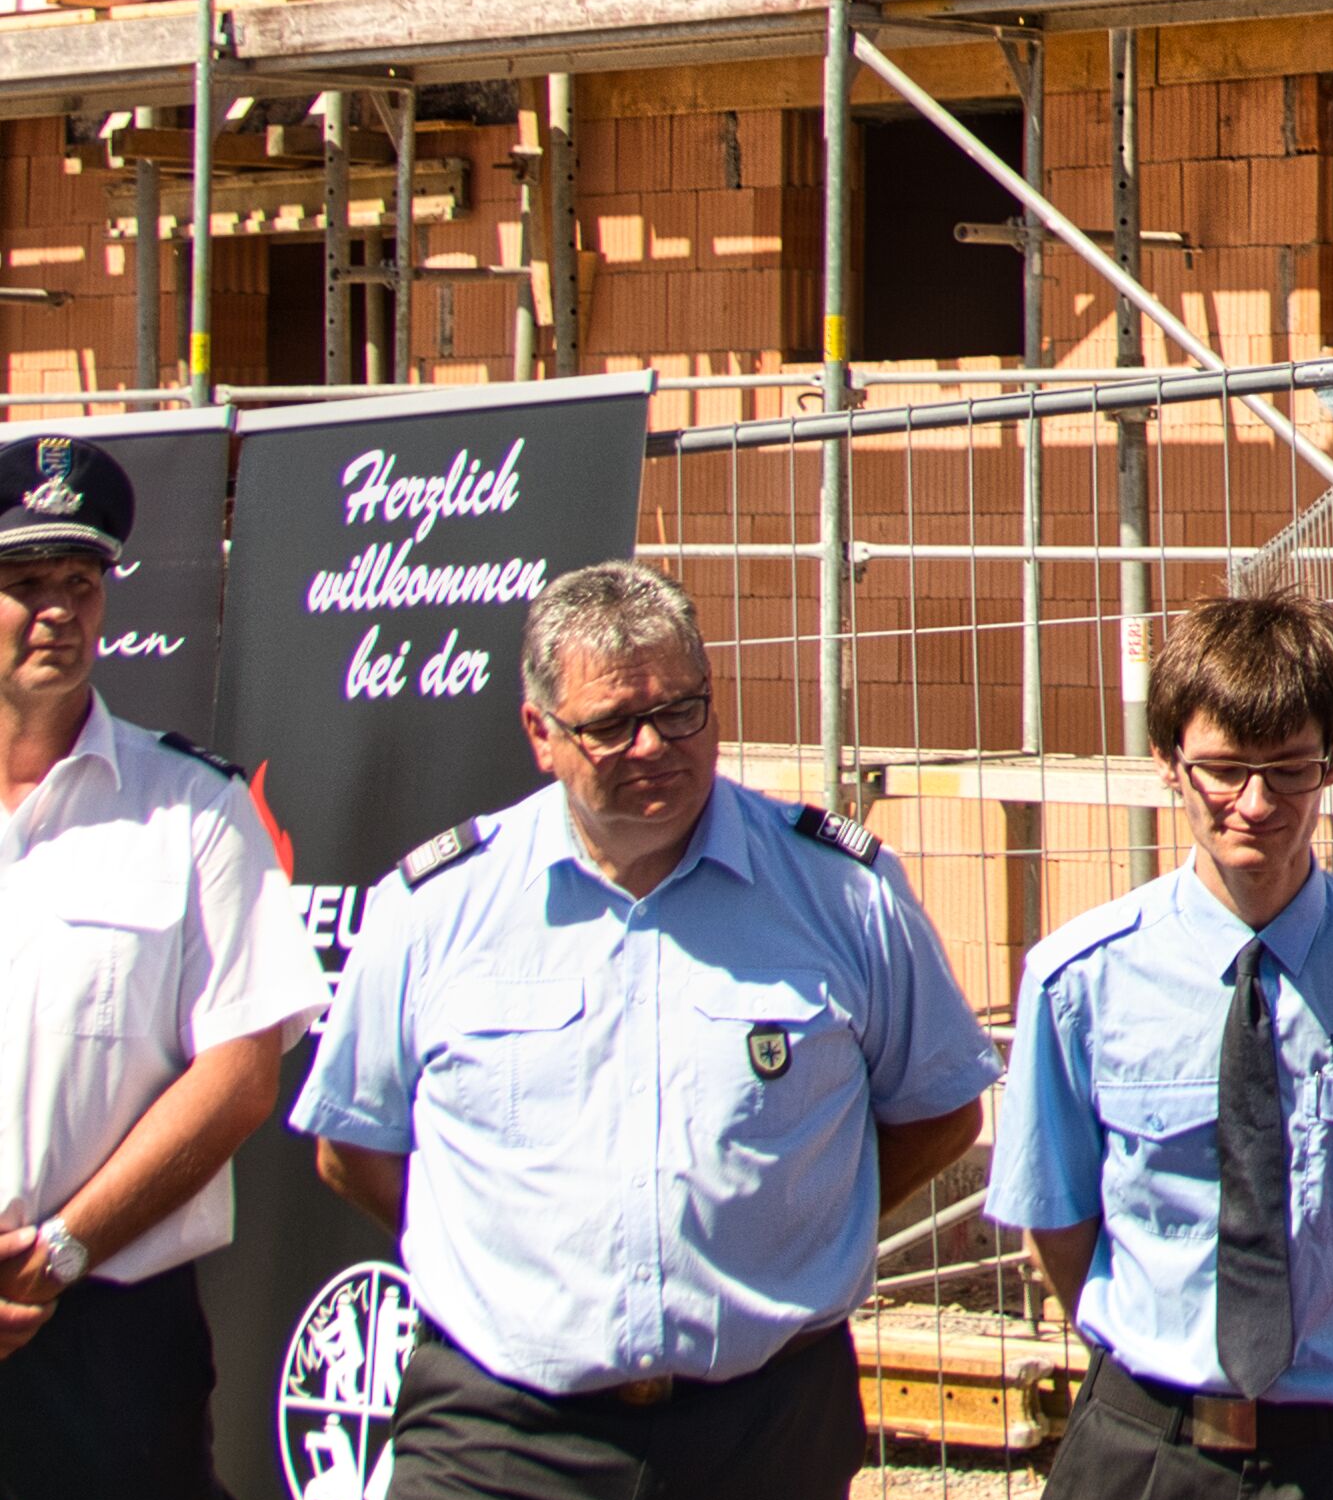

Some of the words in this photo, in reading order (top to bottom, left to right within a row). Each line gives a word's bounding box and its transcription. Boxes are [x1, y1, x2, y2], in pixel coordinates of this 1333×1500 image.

[342, 437, 525, 544] Herzlich
[306, 537, 548, 614] willkommen
[345, 623, 412, 701] bei
[418, 627, 491, 698] der
